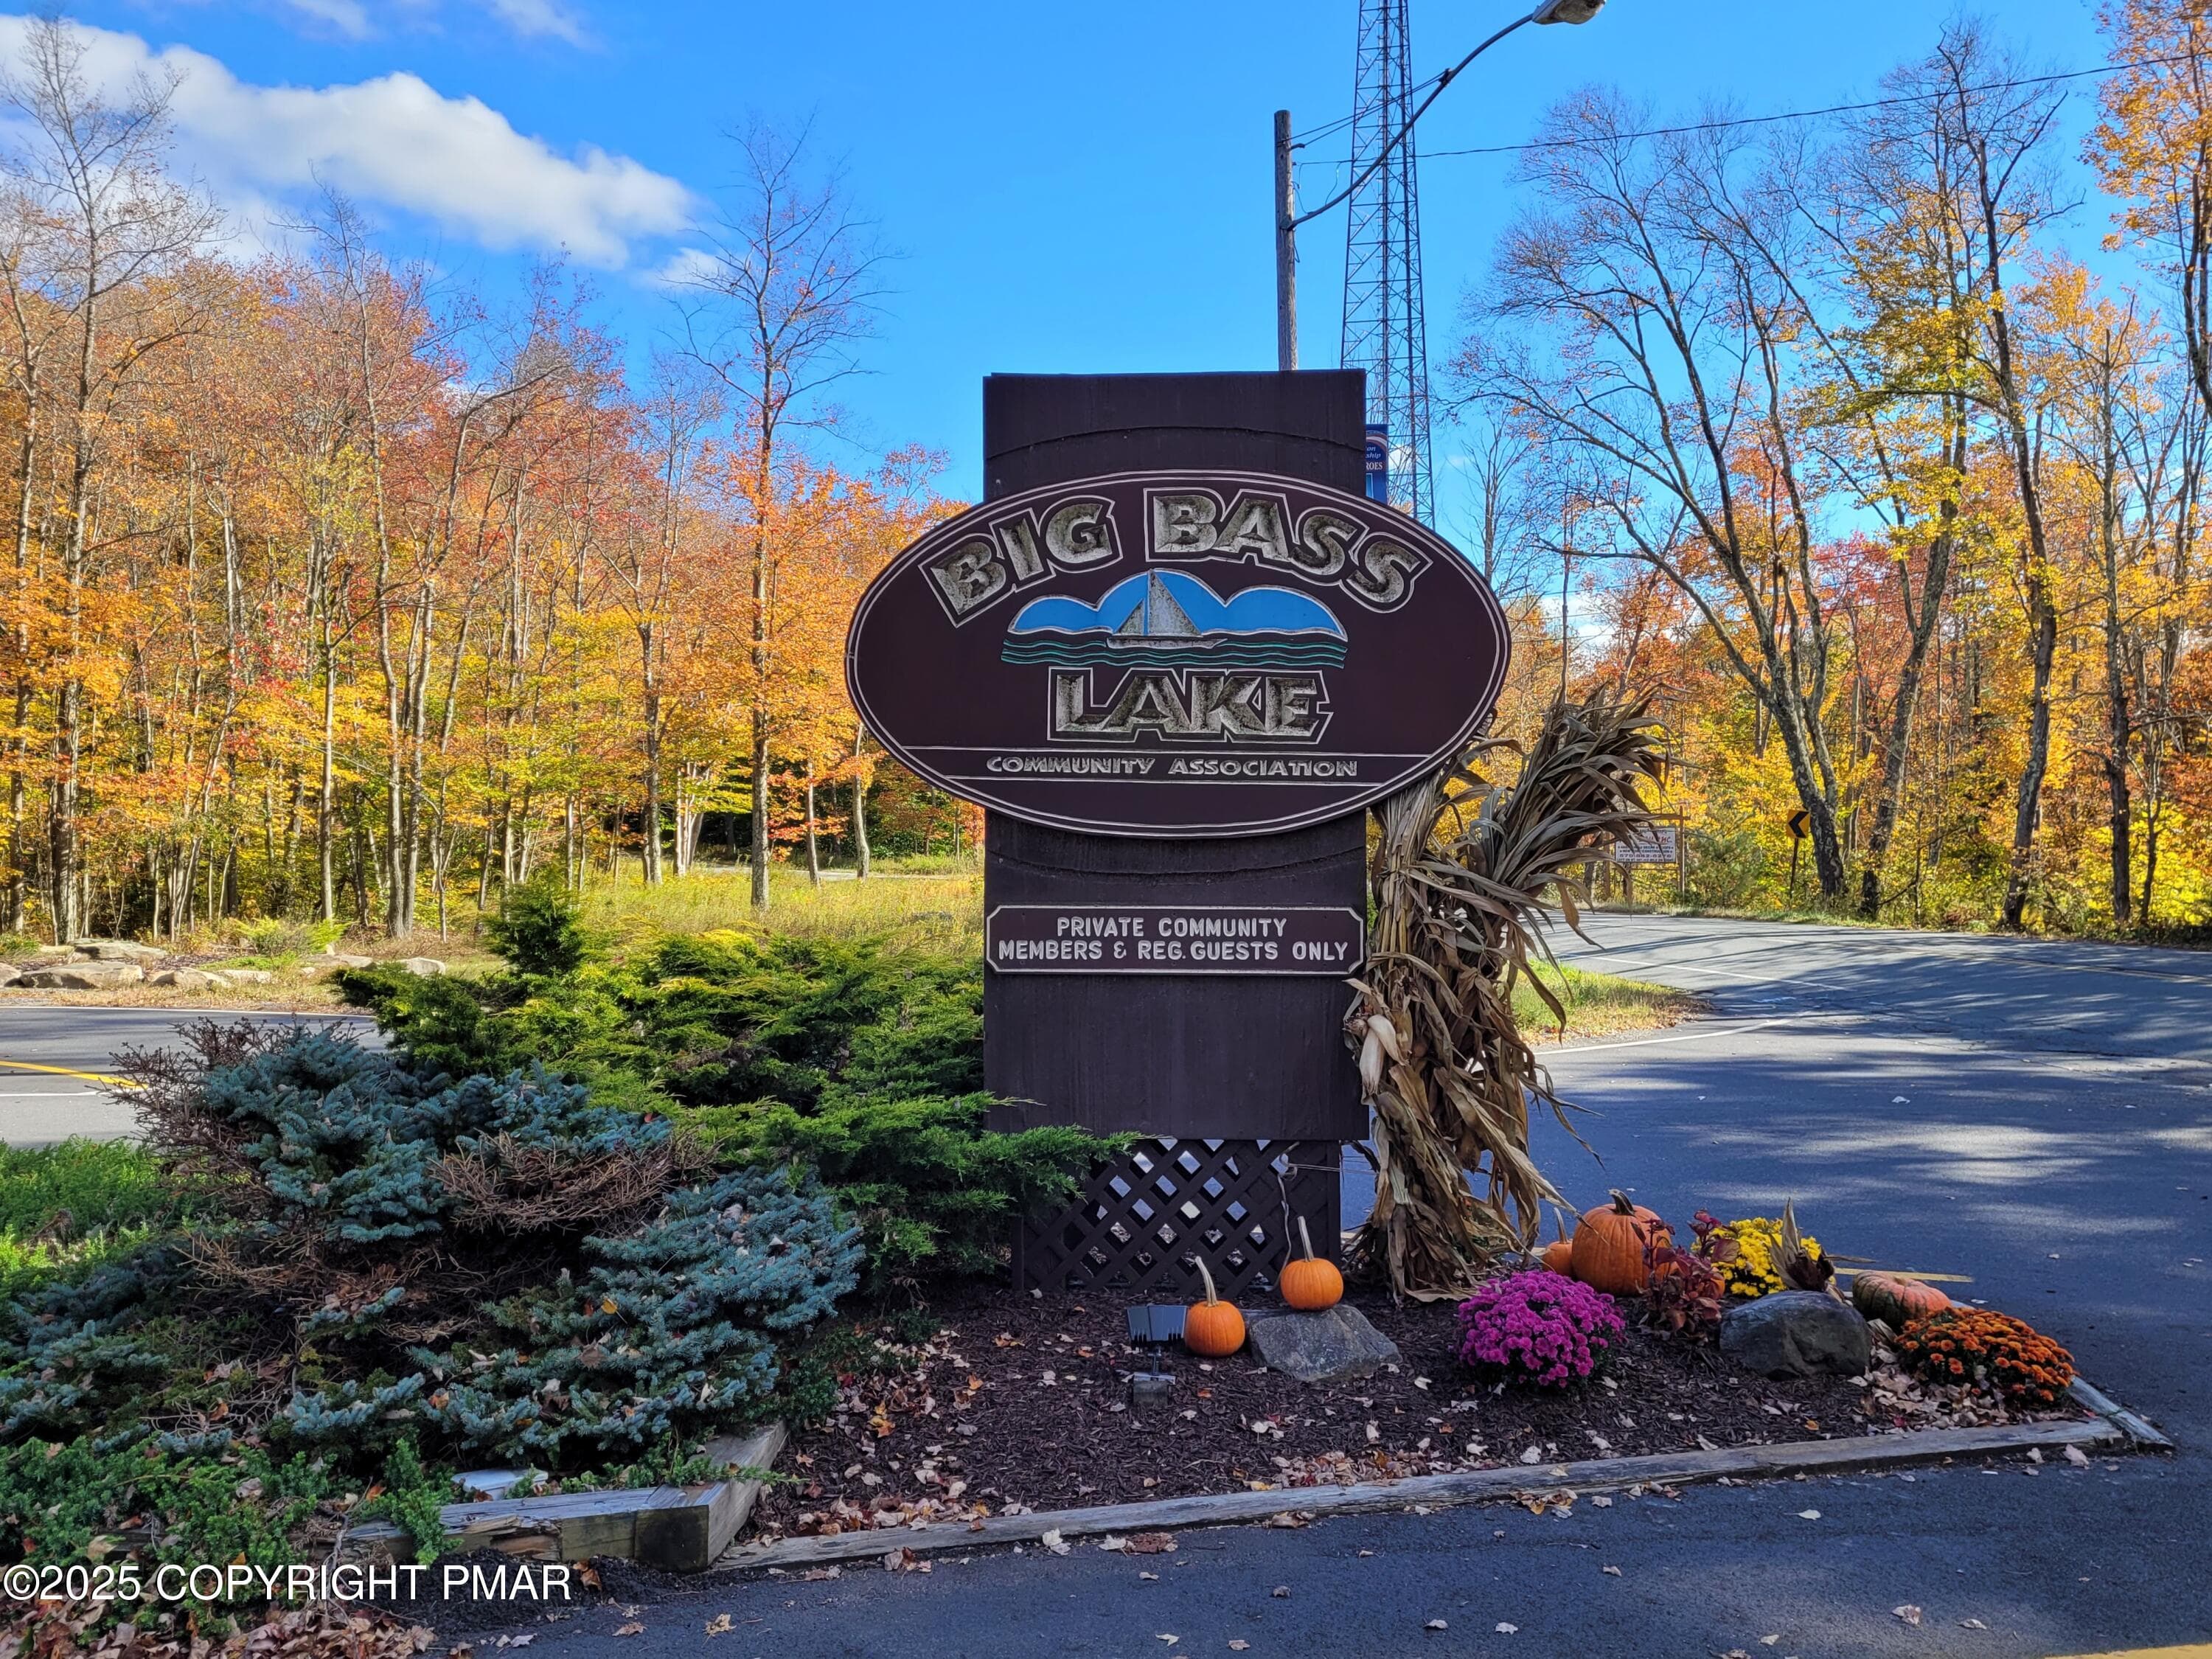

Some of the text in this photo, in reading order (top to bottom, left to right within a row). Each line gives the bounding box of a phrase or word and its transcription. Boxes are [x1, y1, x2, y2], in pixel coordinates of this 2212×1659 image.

[930, 493, 1421, 612] BIG BASS
[1054, 672, 1323, 737] LAKE
[986, 755, 1358, 777] COMMUNITY ASSOCIATION
[1057, 917, 1288, 937] PRIVATE COMMUNITY
[998, 939, 1103, 960] MEMBERS
[1113, 942, 1127, 959] &
[1292, 941, 1349, 961] ONLY
